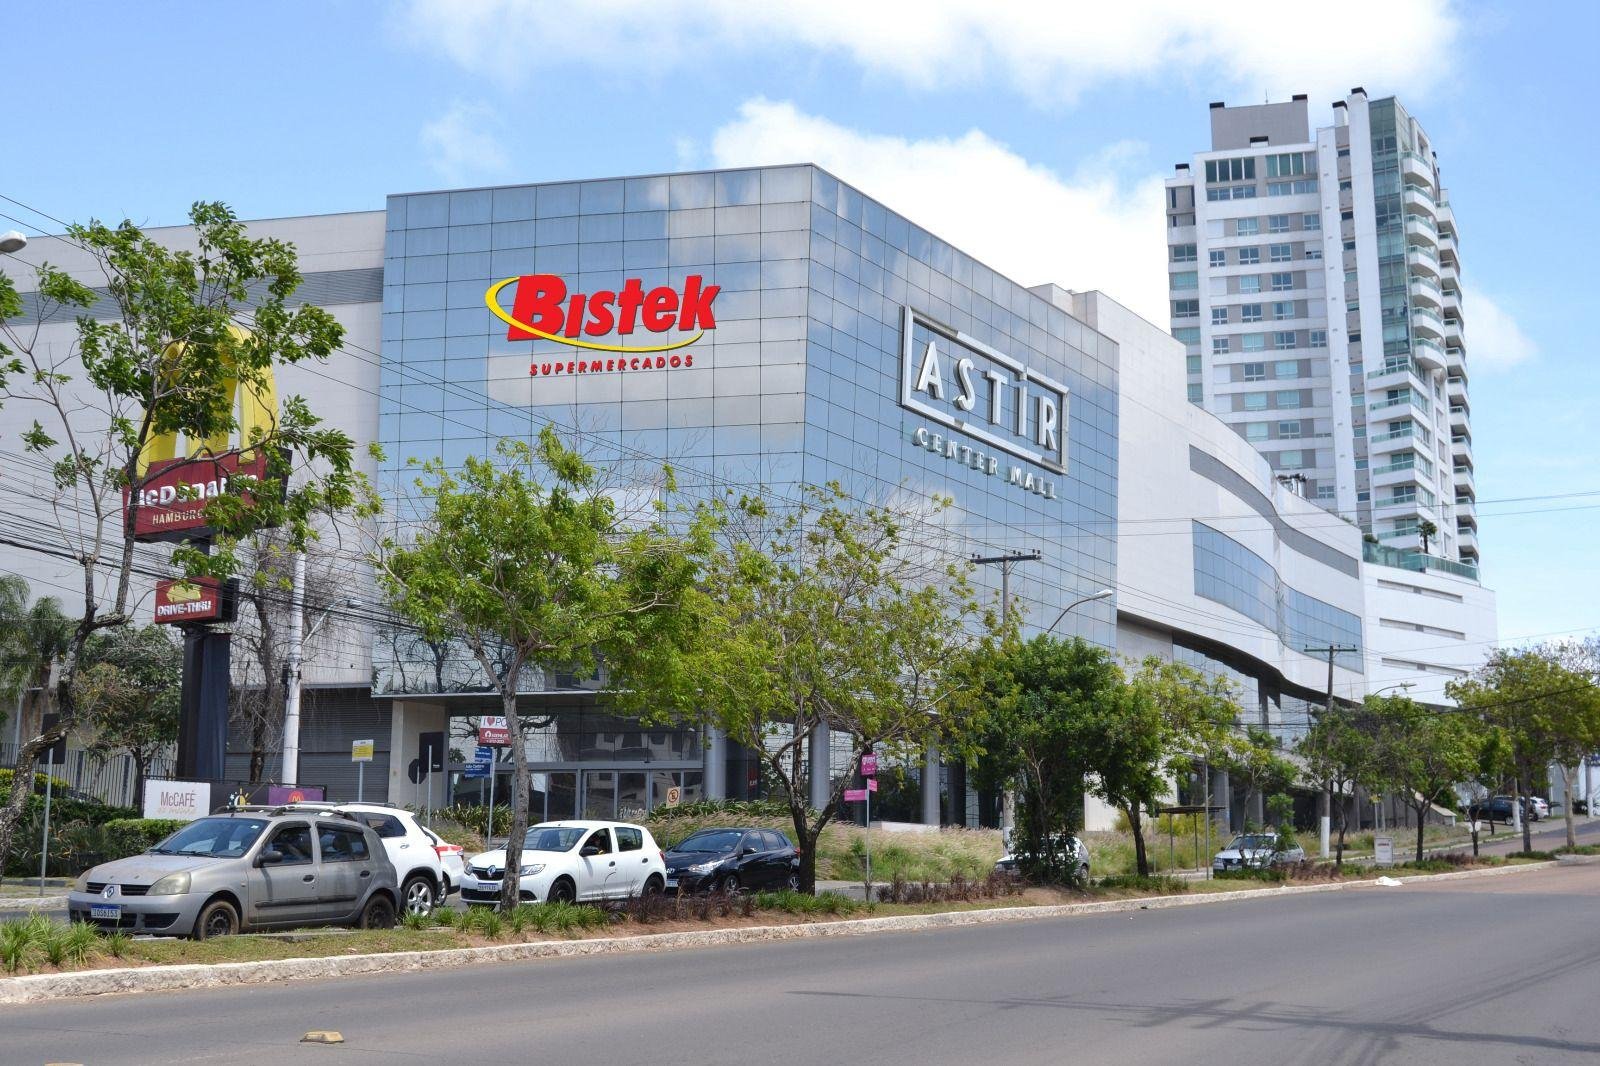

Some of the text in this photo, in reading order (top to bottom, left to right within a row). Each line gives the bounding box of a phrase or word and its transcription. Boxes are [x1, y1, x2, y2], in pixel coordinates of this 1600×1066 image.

[529, 354, 694, 377] SUPERMERCADOS
[912, 427, 1058, 500] CENTER MALL
[157, 600, 212, 616] DRIVE-THRU
